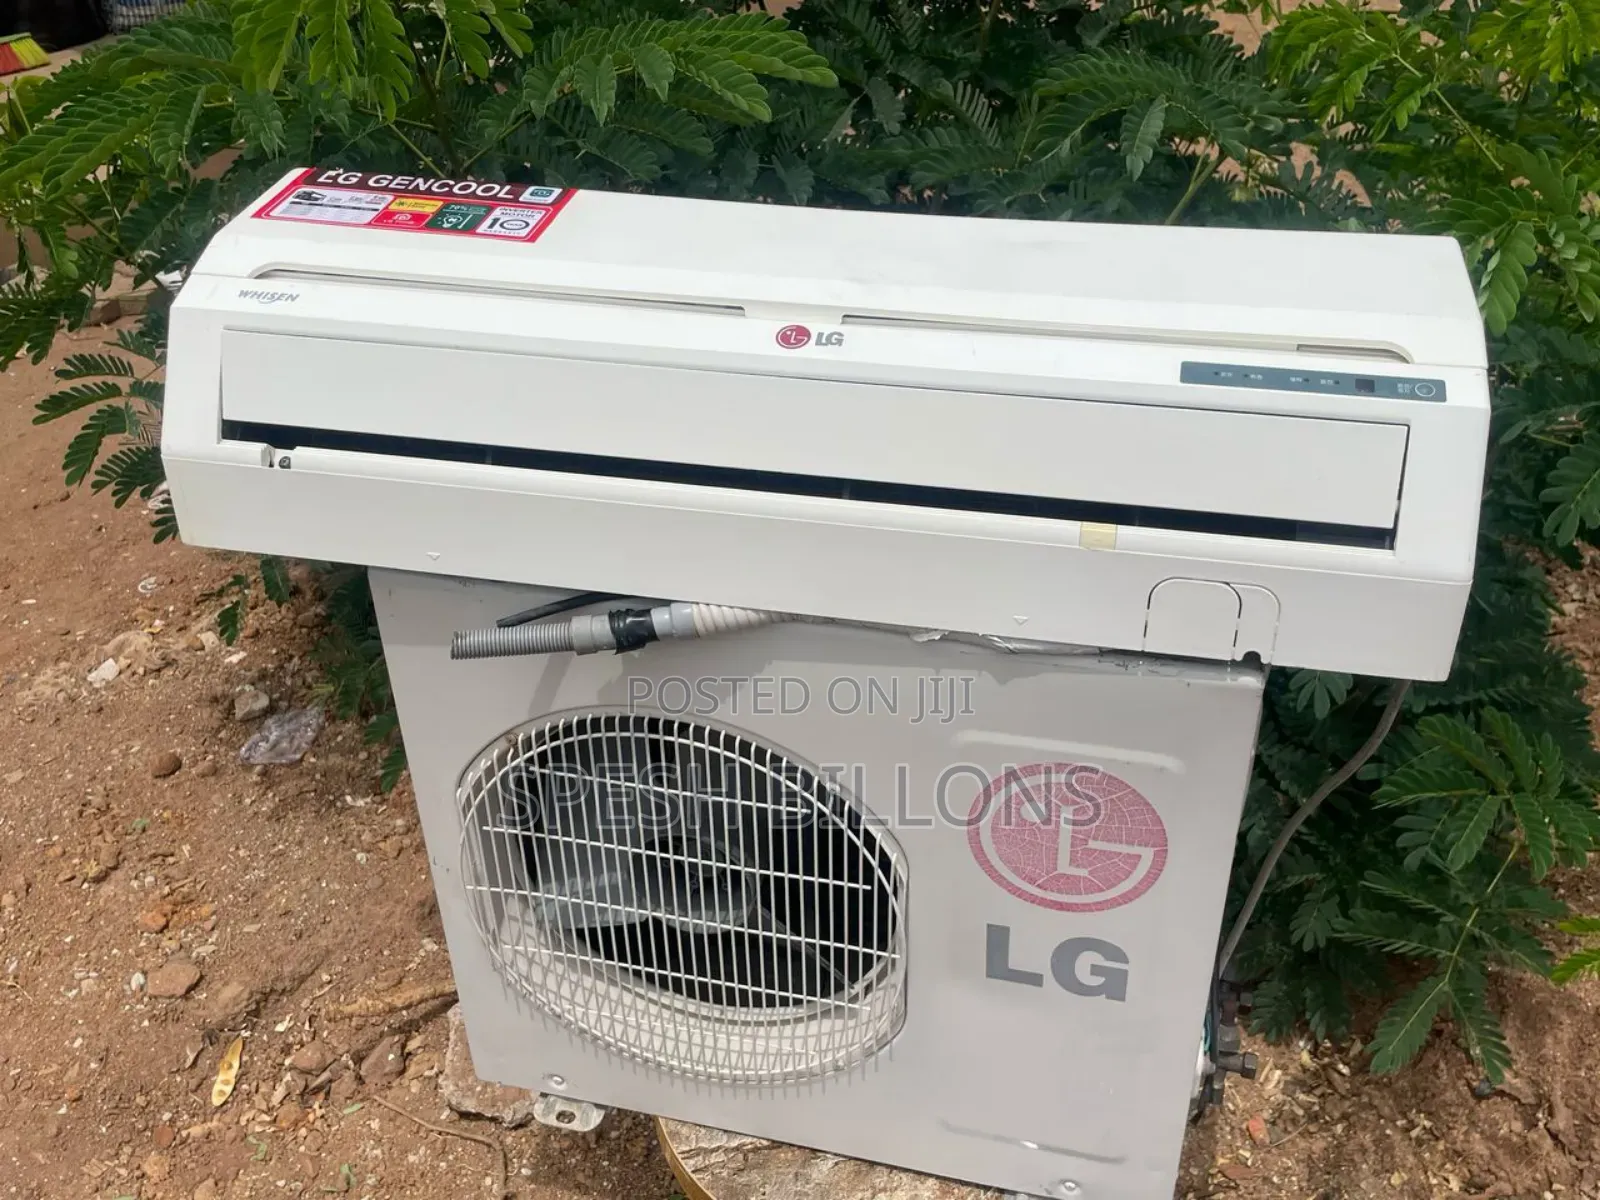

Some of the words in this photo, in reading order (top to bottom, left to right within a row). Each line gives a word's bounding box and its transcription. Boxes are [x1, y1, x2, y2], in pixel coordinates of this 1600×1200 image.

[368, 175, 515, 199] GENCOOL
[237, 289, 300, 304] WHISEN
[815, 331, 845, 346] LG
[985, 922, 1130, 1003] LG
